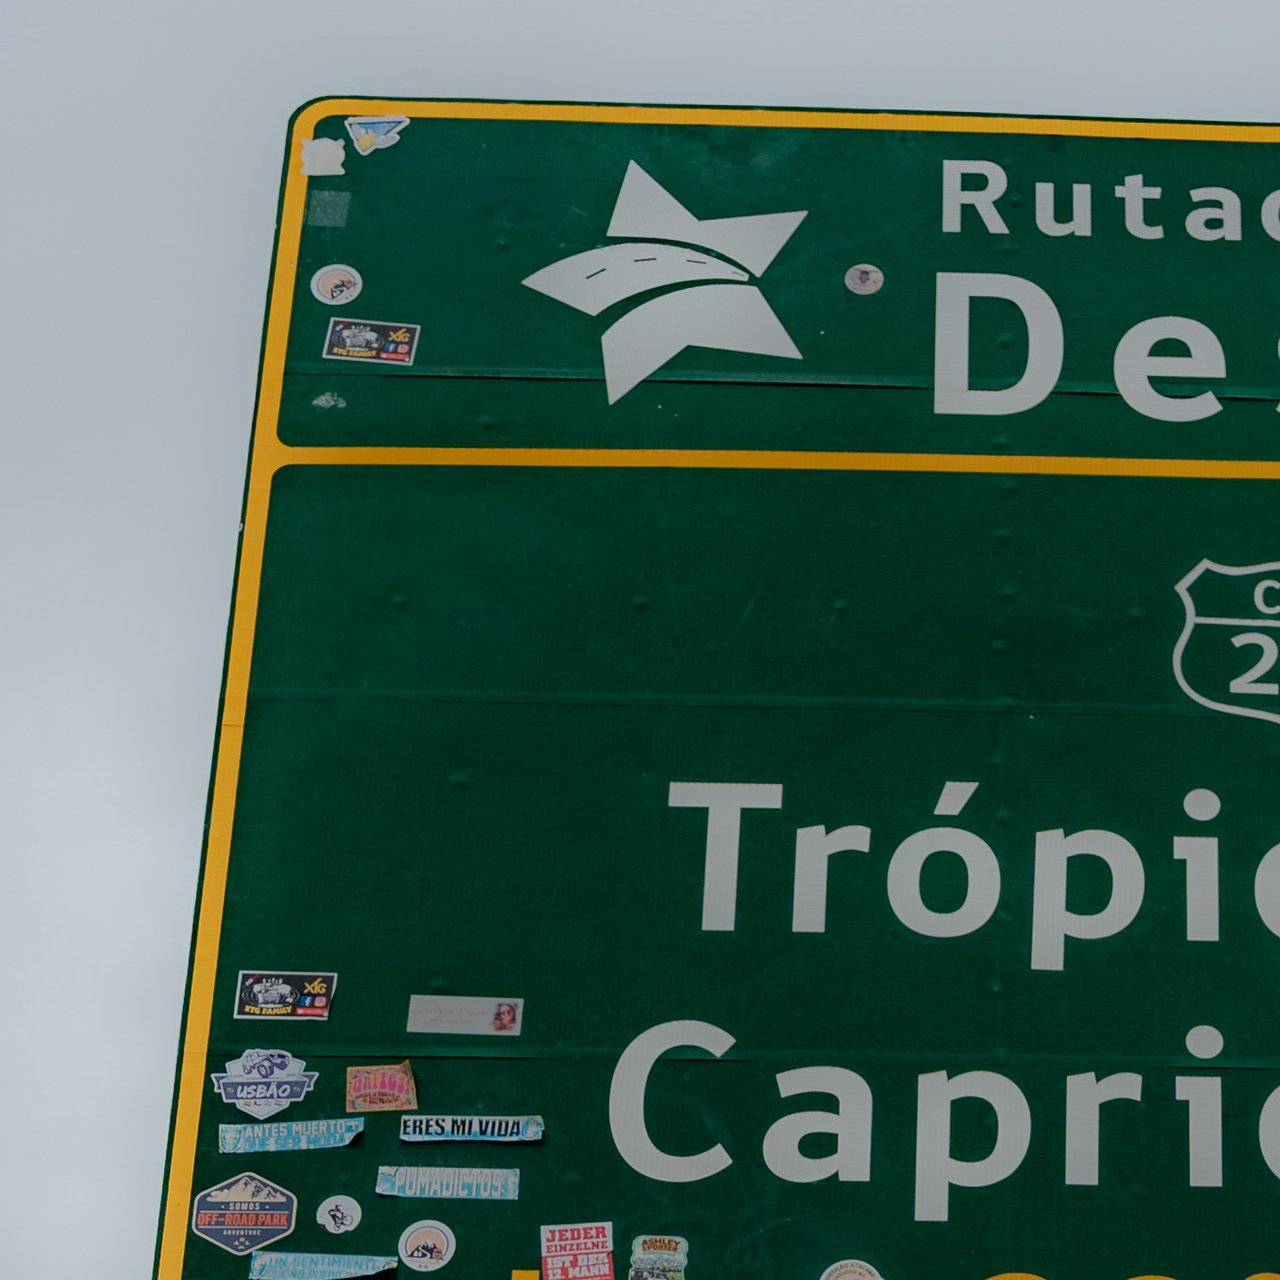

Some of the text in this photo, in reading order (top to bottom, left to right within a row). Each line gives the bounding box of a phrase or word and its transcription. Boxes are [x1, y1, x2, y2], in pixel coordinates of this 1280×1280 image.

[237, 1080, 291, 1098] USBÃO
[244, 1119, 345, 1138] ANTES MUERTO
[402, 1118, 520, 1136] ERES MI VIDA
[395, 1167, 502, 1197] PUMADICTOS
[229, 1203, 260, 1211] SOMOS
[198, 1213, 288, 1226] OFF-ROAD PARK
[546, 1226, 607, 1242] JEDER
[546, 1240, 608, 1253] EINZELNE
[547, 1253, 609, 1268] IST DER
[548, 1264, 610, 1280] 12. MANN
